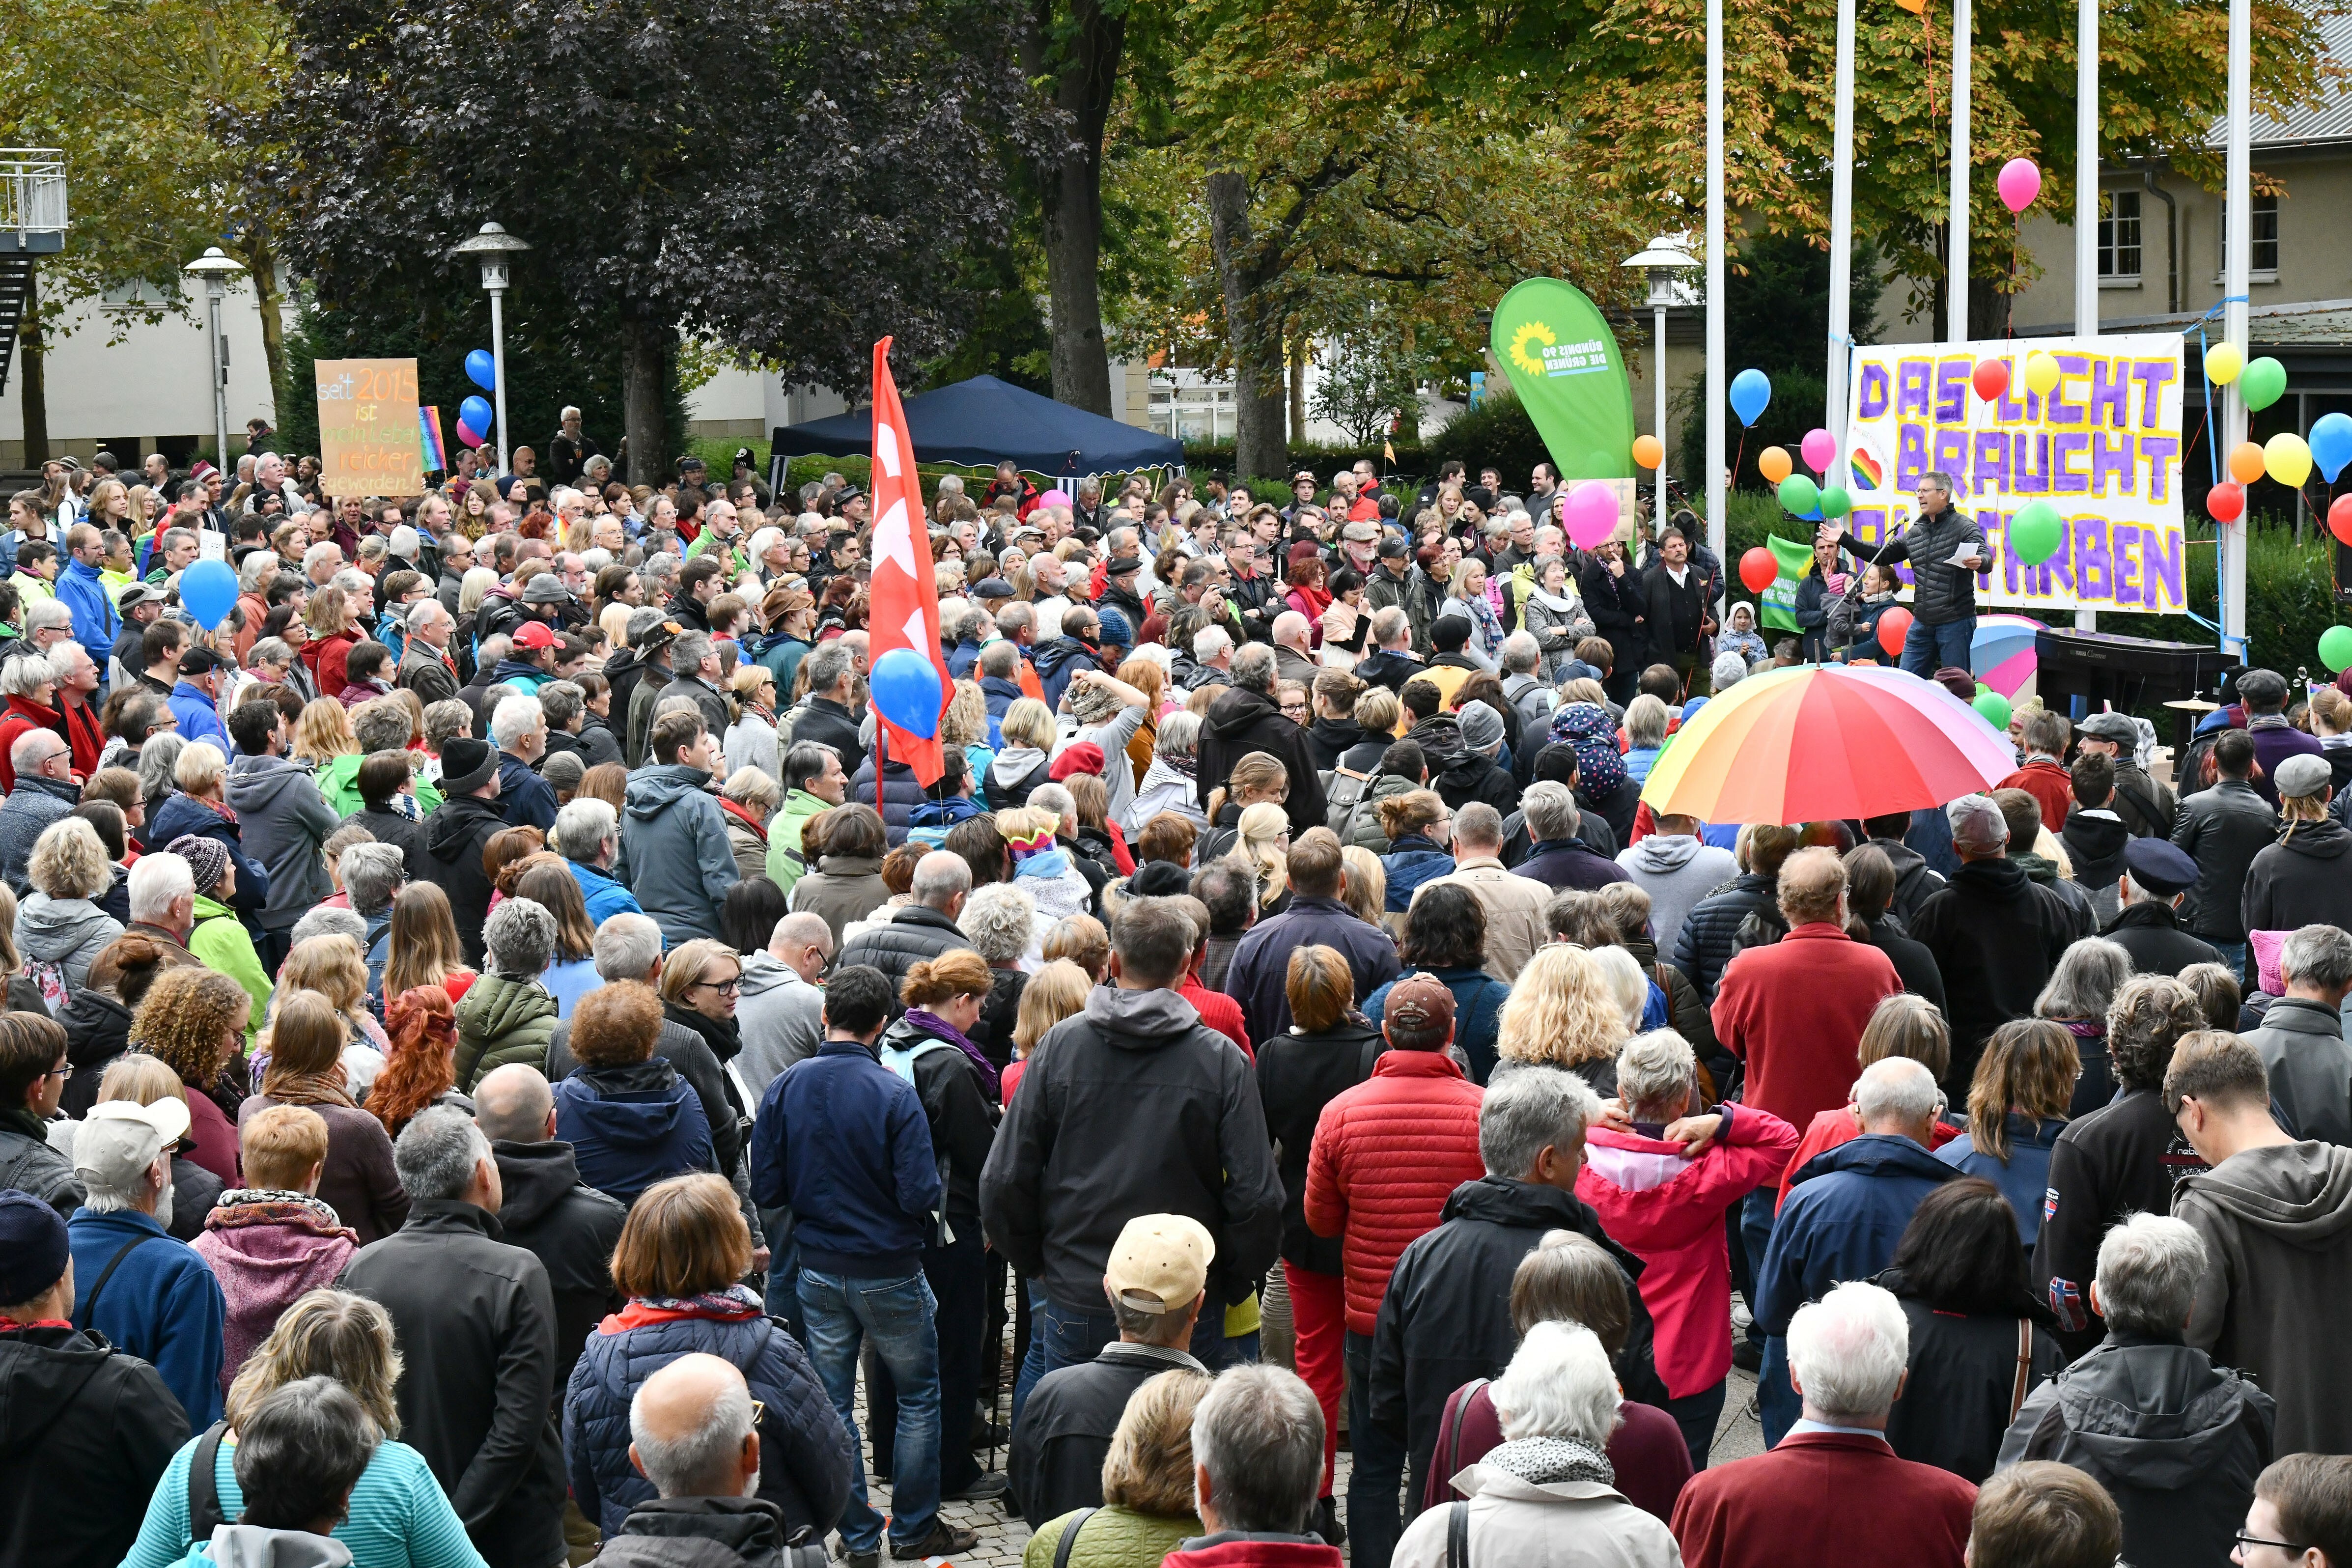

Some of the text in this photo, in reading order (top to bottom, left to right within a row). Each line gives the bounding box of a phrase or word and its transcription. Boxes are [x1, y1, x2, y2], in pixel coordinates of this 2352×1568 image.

[317, 368, 418, 402] seit 2015
[1858, 359, 1973, 424] DAS
[356, 403, 377, 421] ist
[323, 424, 366, 443] mein
[339, 446, 414, 472] reicher
[1897, 423, 2179, 500] BRAUCHT
[327, 467, 418, 491] geworden!
